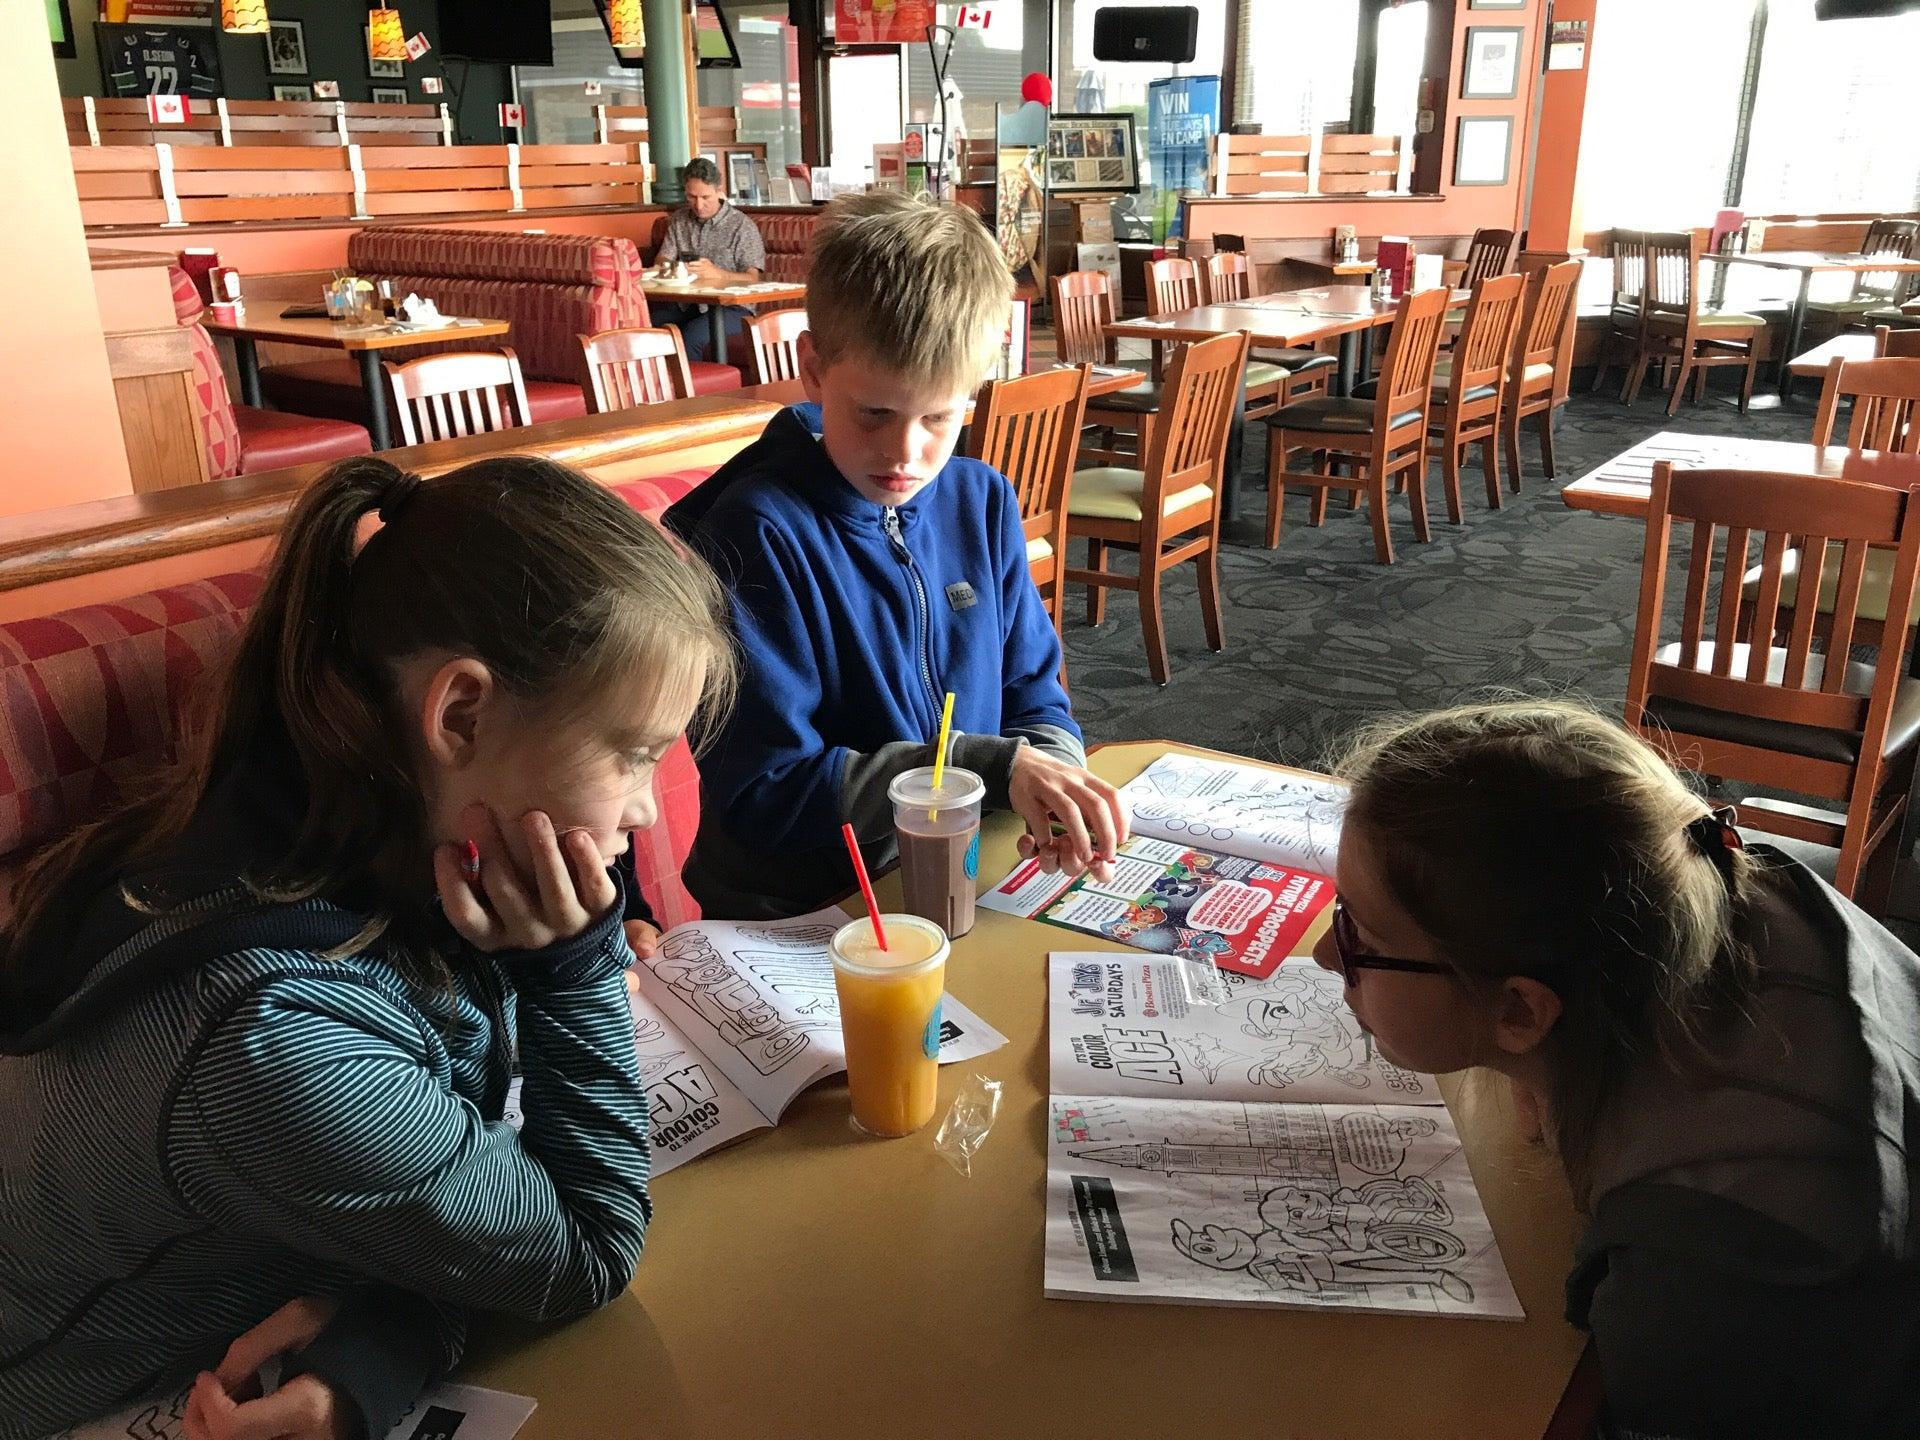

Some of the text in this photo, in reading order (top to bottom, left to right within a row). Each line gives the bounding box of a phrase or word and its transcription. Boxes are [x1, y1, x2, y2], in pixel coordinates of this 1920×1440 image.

[1159, 92, 1190, 115] WIN
[1176, 129, 1203, 145] CAMP
[1274, 874, 1310, 909] FUTURE
[1239, 905, 1290, 967] PROSPECTS
[1071, 963, 1104, 993] JAYS
[1106, 963, 1126, 1018] SATURDAYS
[1142, 965, 1155, 1008] Boston Pizza
[1083, 1034, 1114, 1069] COLOUR
[1103, 1027, 1183, 1085] ACE
[640, 1064, 718, 1135] AC
[651, 1101, 720, 1148] COLOUR
[668, 1117, 720, 1152] IT'S TIME TO
